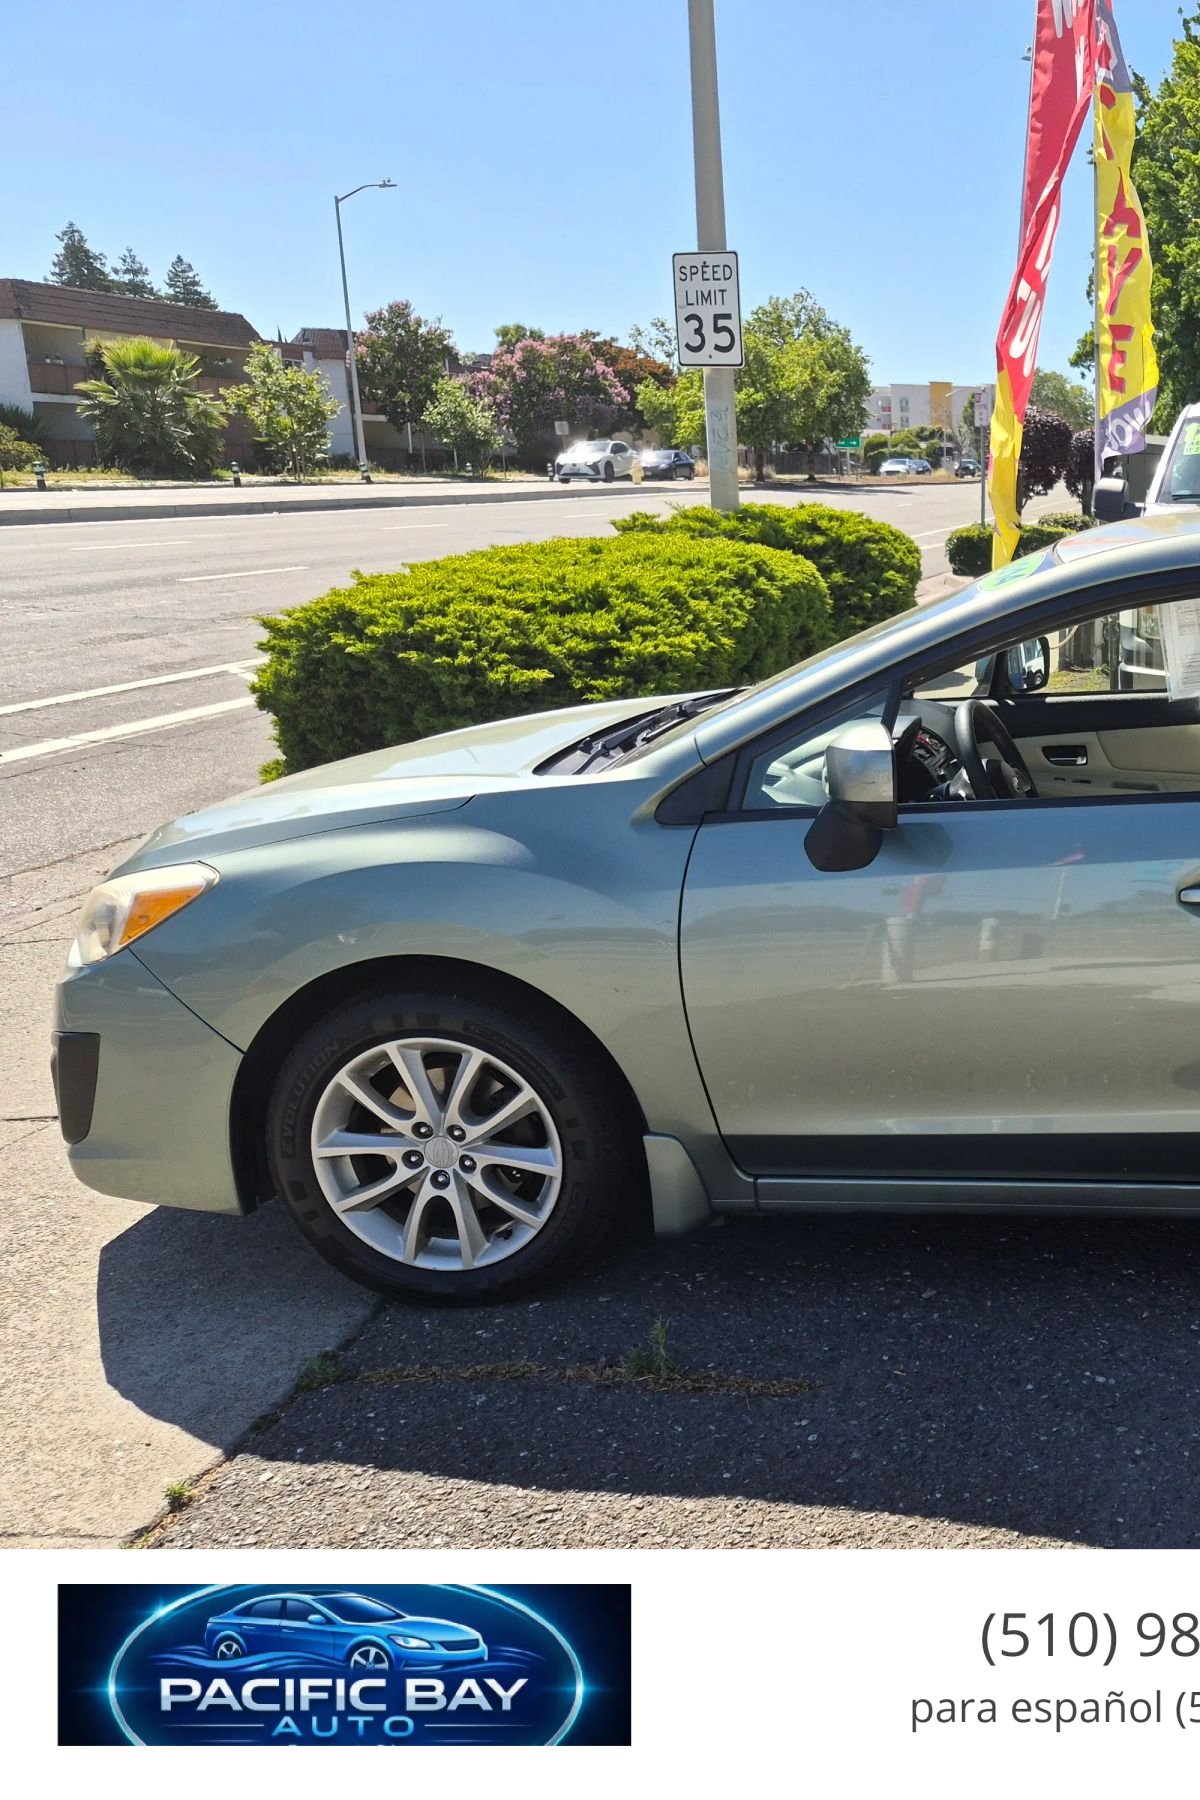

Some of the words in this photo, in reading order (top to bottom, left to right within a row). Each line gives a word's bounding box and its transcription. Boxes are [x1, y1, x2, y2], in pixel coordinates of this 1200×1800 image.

[679, 264, 733, 282] SPEED
[685, 288, 727, 306] LIMIT
[683, 313, 736, 354] 35
[282, 1040, 341, 1155] EVOLUTION
